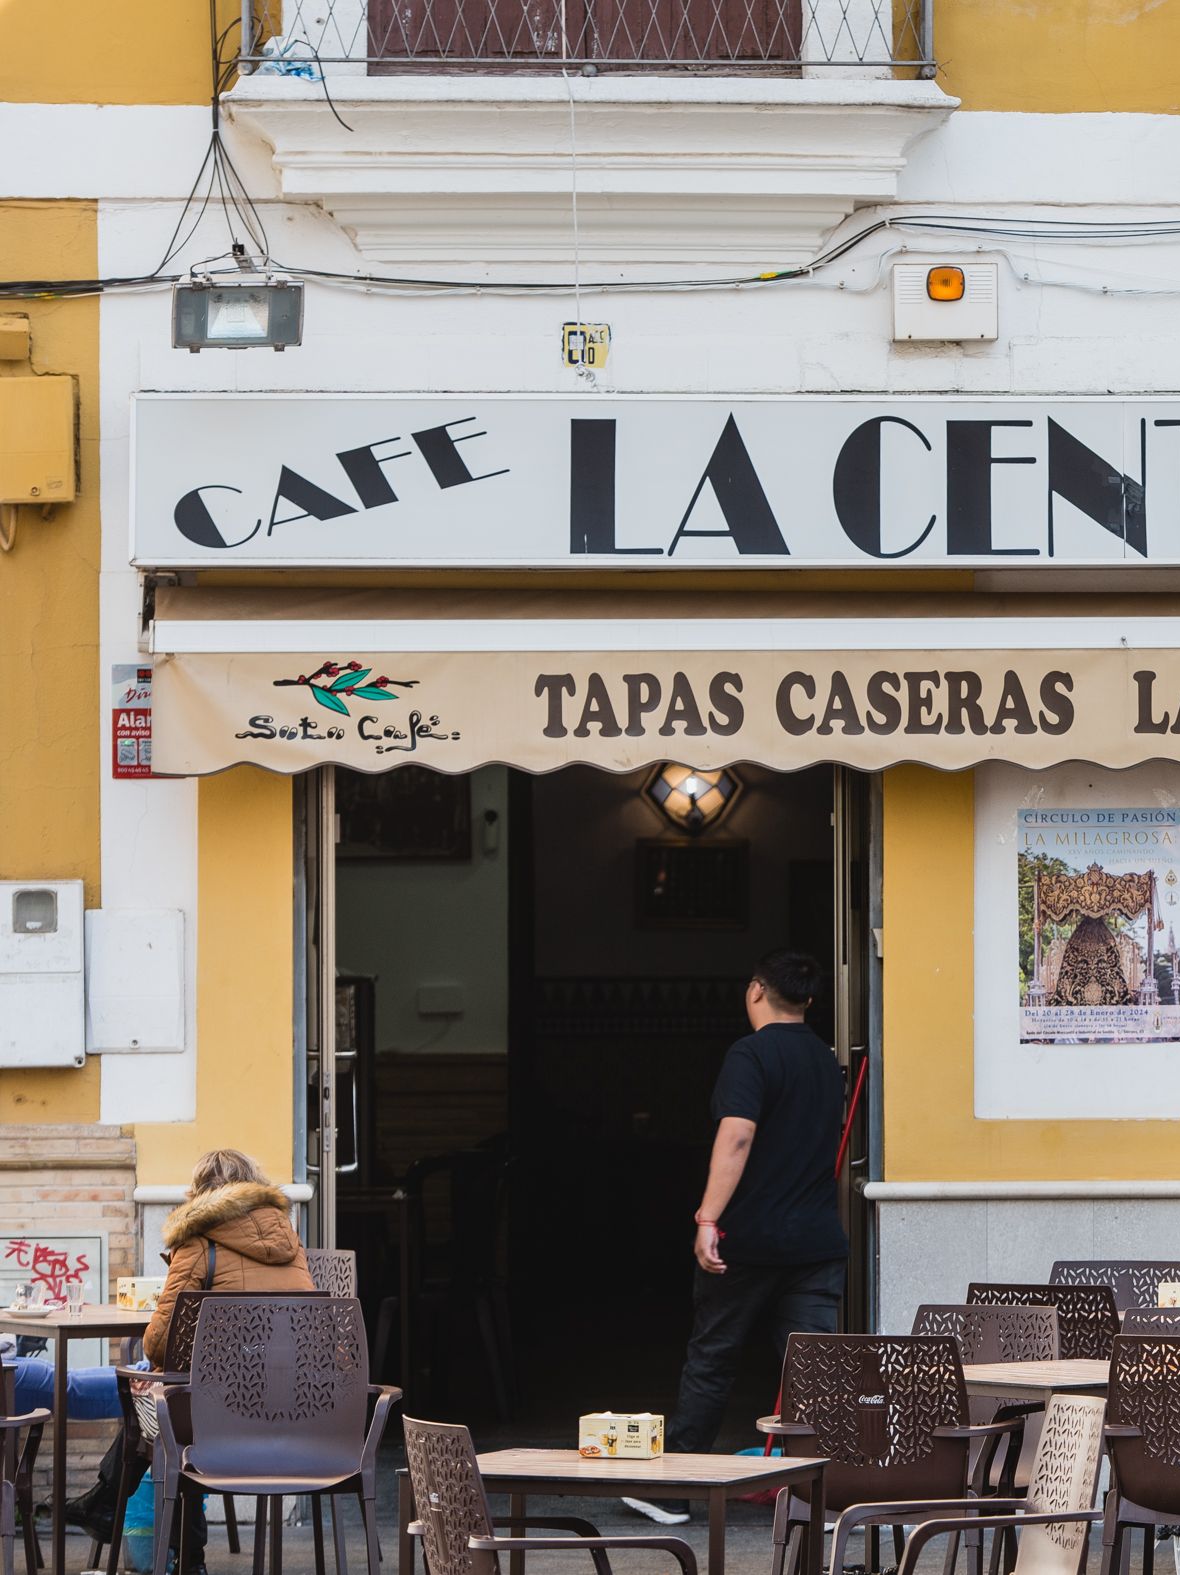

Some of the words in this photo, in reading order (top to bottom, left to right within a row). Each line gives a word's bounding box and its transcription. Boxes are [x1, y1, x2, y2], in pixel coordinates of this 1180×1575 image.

[174, 416, 511, 549] CAFE
[570, 412, 791, 557] LA
[535, 671, 745, 738] TAPAS
[776, 670, 1075, 736] CASERAS
[131, 728, 150, 736] aviso
[1024, 811, 1090, 824] CÍRCULO
[1096, 813, 1115, 823] DE
[1122, 810, 1176, 823] PASIÓN
[1024, 832, 1046, 846] LA
[859, 1395, 885, 1404] Coca-Cola
